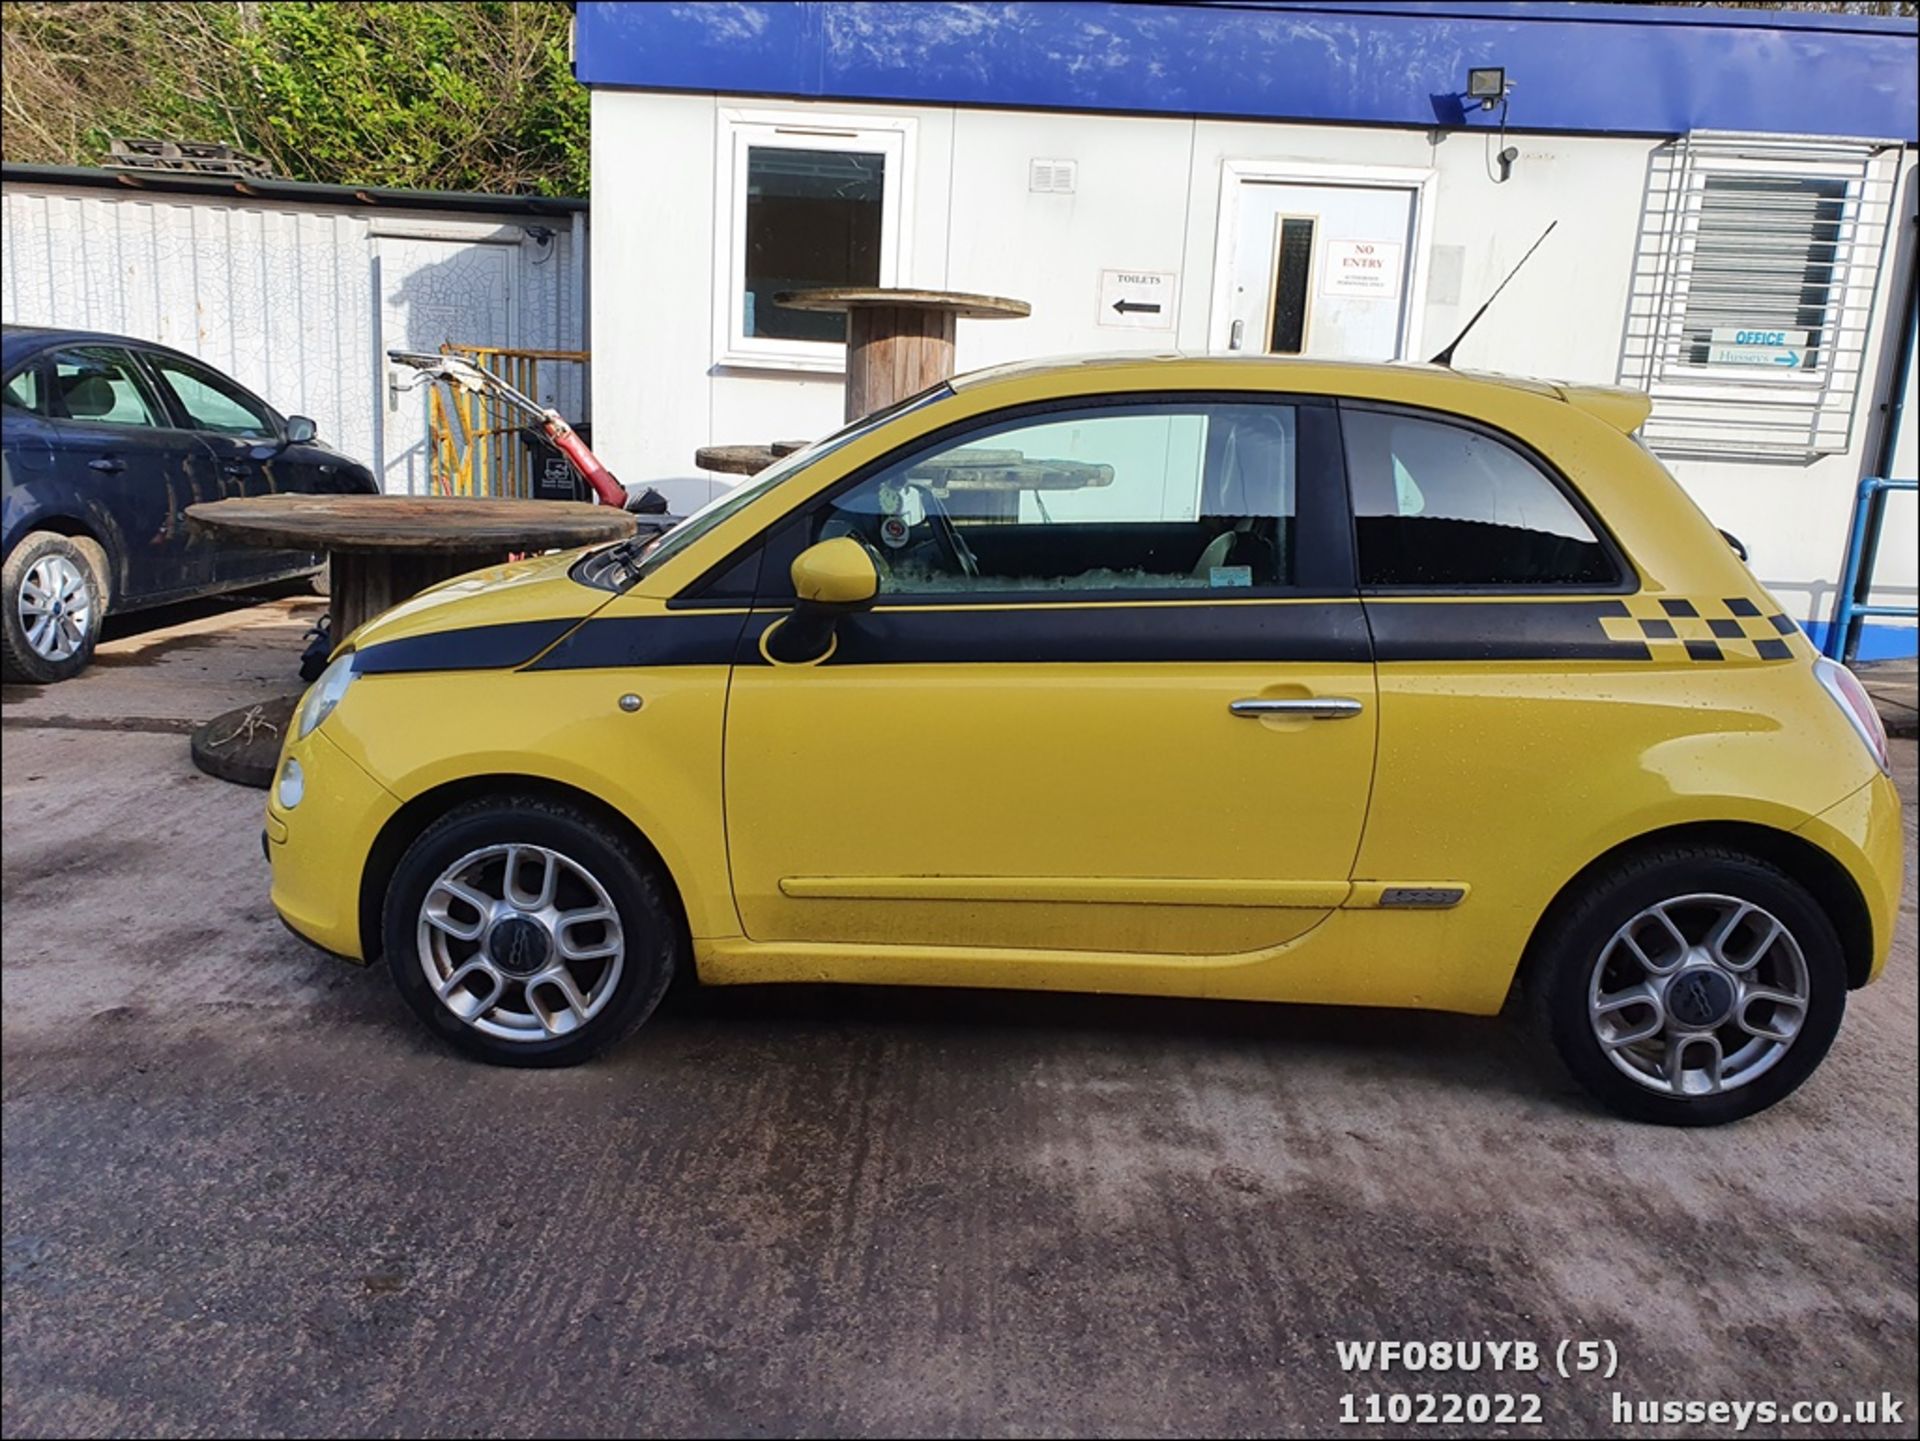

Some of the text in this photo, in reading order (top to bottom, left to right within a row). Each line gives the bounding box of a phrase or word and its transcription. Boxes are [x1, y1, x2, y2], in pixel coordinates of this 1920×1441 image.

[1355, 244, 1375, 255] NO
[1342, 257, 1385, 269] ENTRY
[1117, 274, 1161, 285] TOILETS
[1735, 330, 1786, 346] OFFICE
